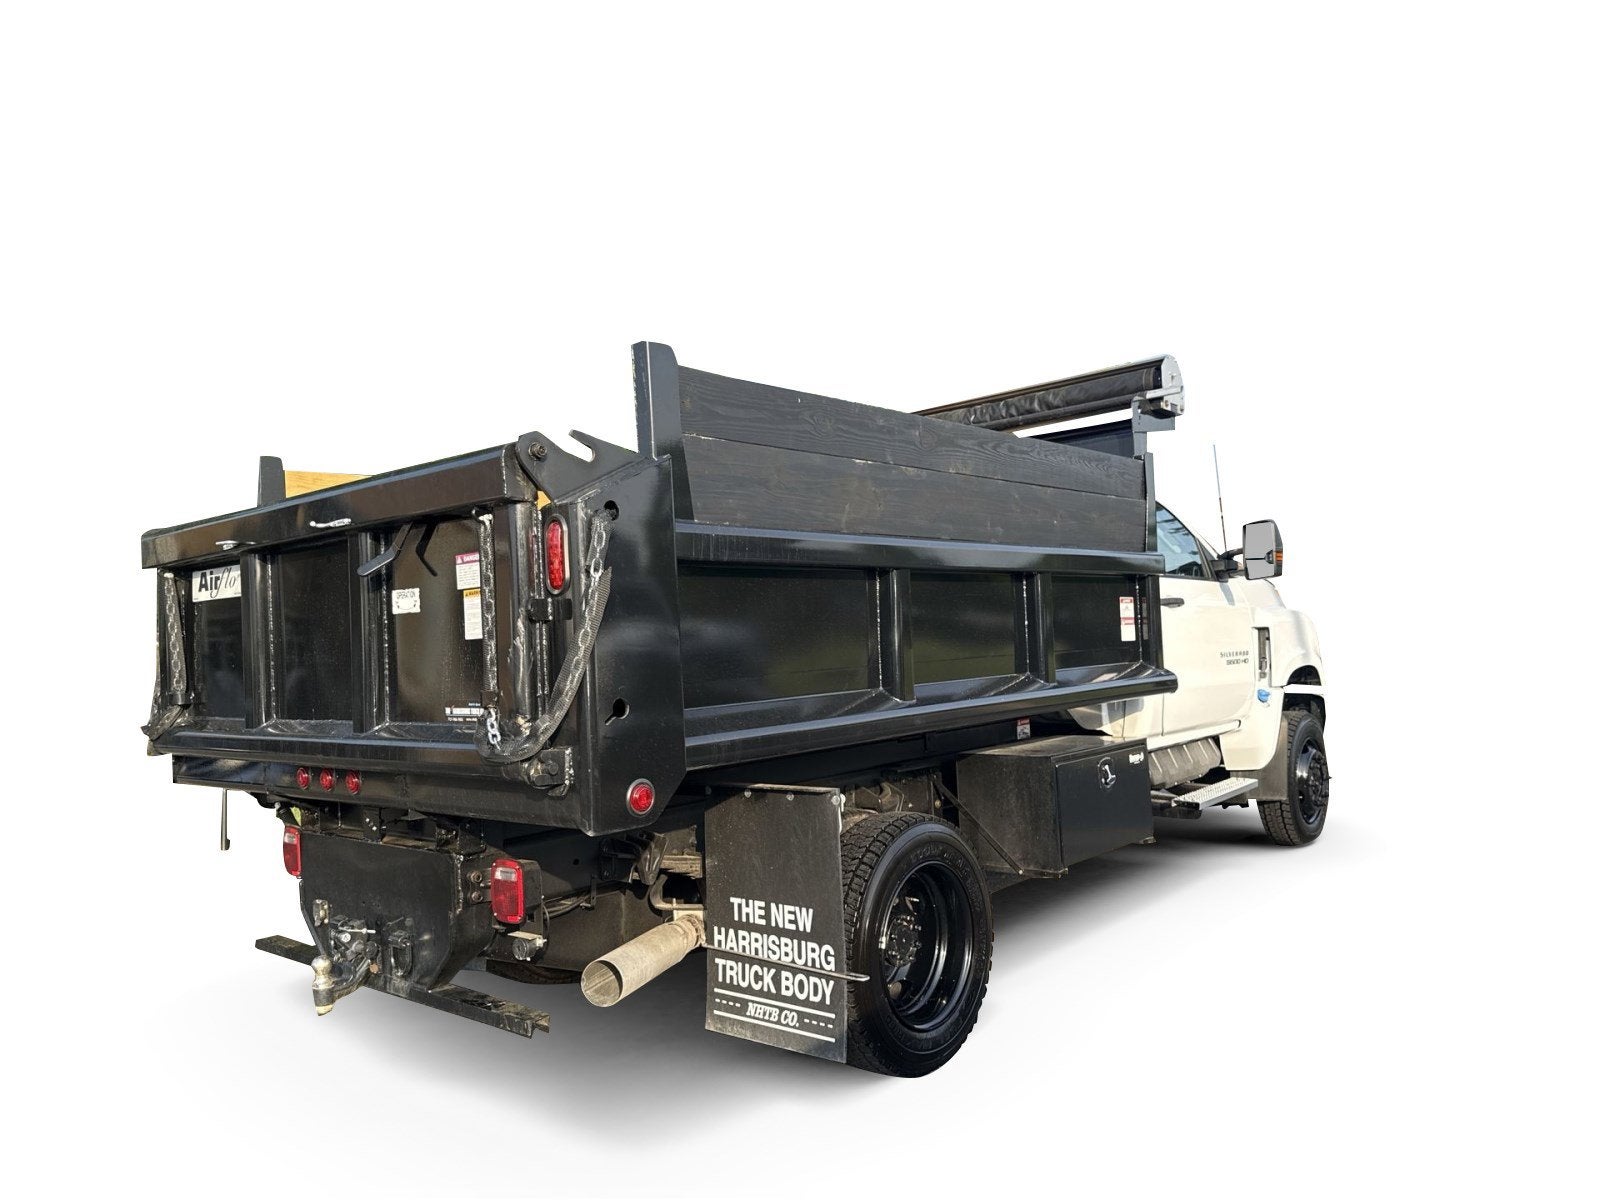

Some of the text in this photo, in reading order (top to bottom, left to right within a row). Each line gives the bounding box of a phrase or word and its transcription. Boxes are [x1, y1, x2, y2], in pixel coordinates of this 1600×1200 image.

[729, 896, 813, 933] THE NEW
[713, 925, 836, 972] HARRISBURG
[714, 957, 835, 1005] TRUCK BODY
[745, 1001, 800, 1028] NHTB CO.
